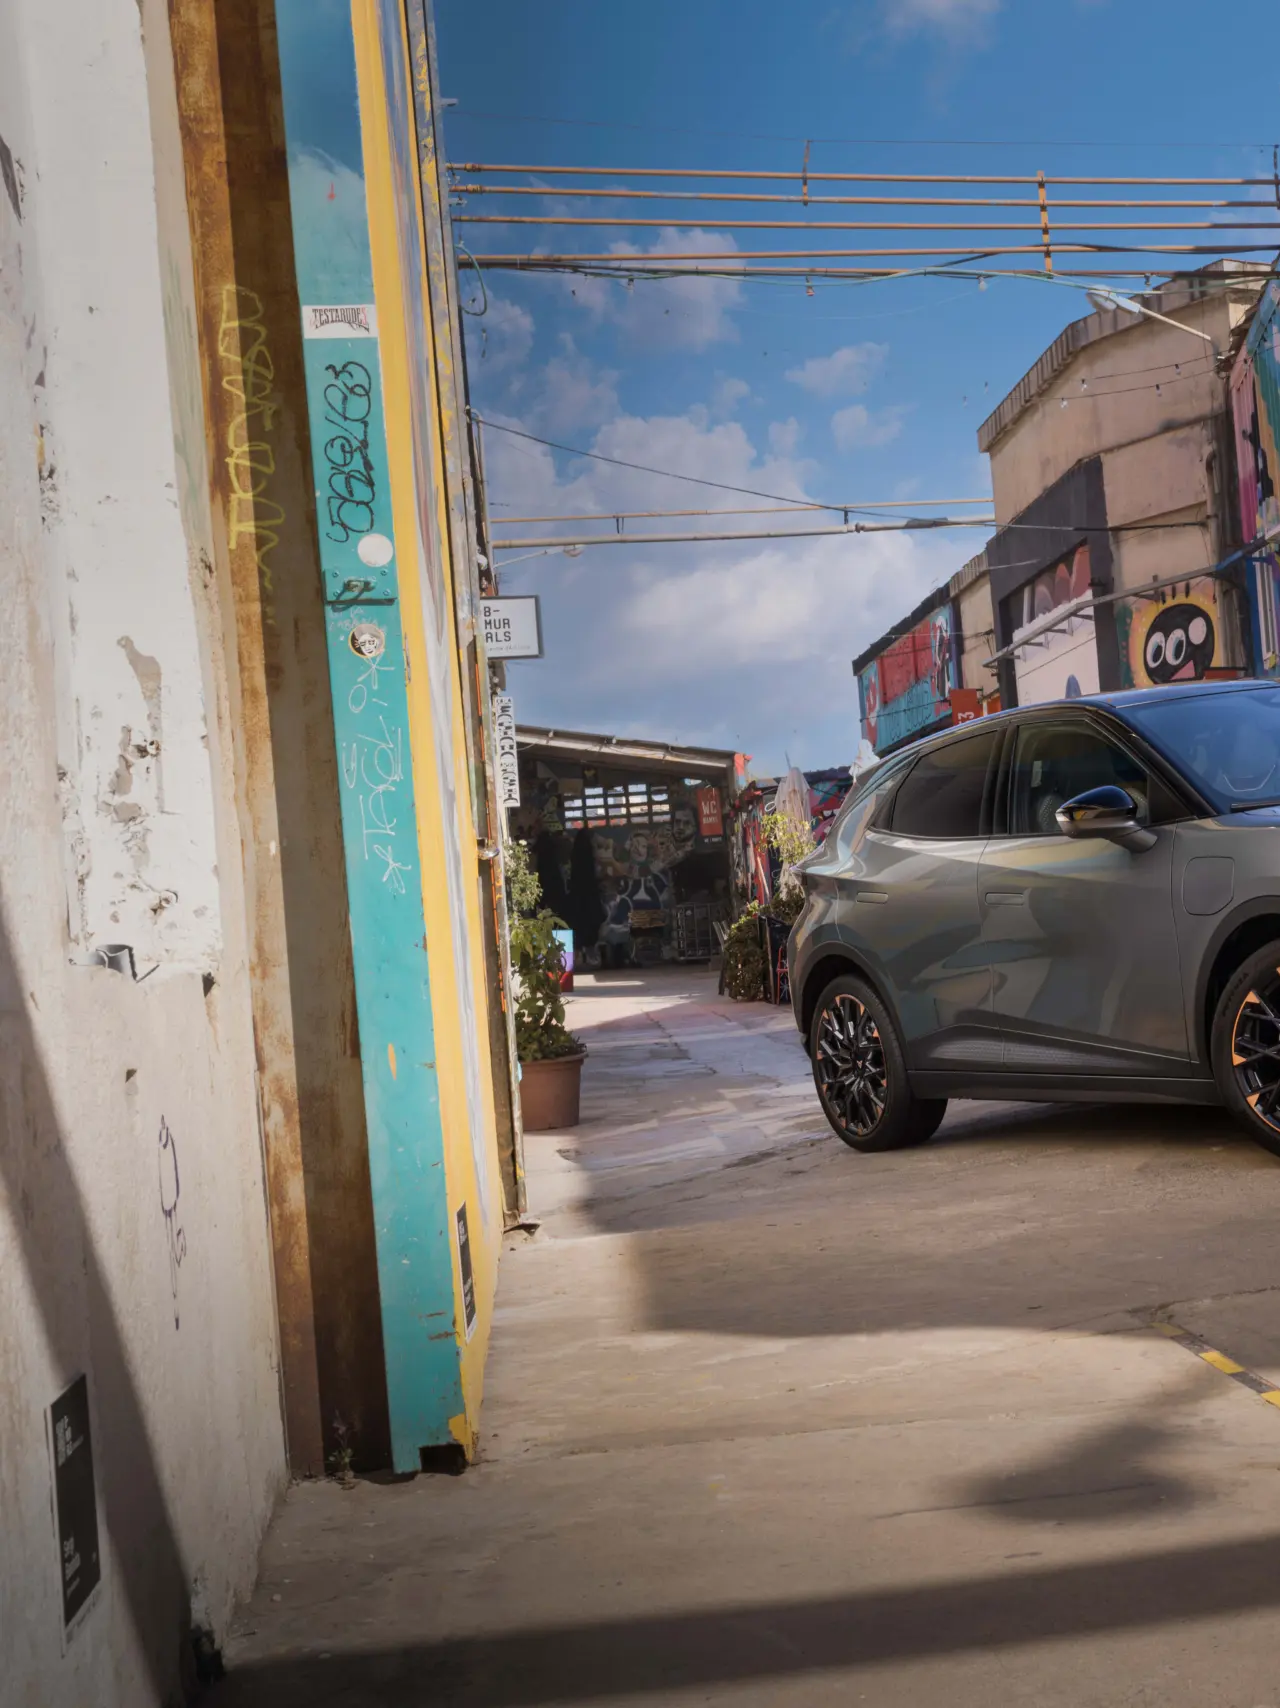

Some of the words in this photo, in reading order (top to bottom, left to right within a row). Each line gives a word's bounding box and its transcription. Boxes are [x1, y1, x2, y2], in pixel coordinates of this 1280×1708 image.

[311, 305, 369, 331] TESTARUDES
[484, 618, 511, 630] MUR
[485, 631, 512, 643] ALS
[701, 800, 718, 816] WC
